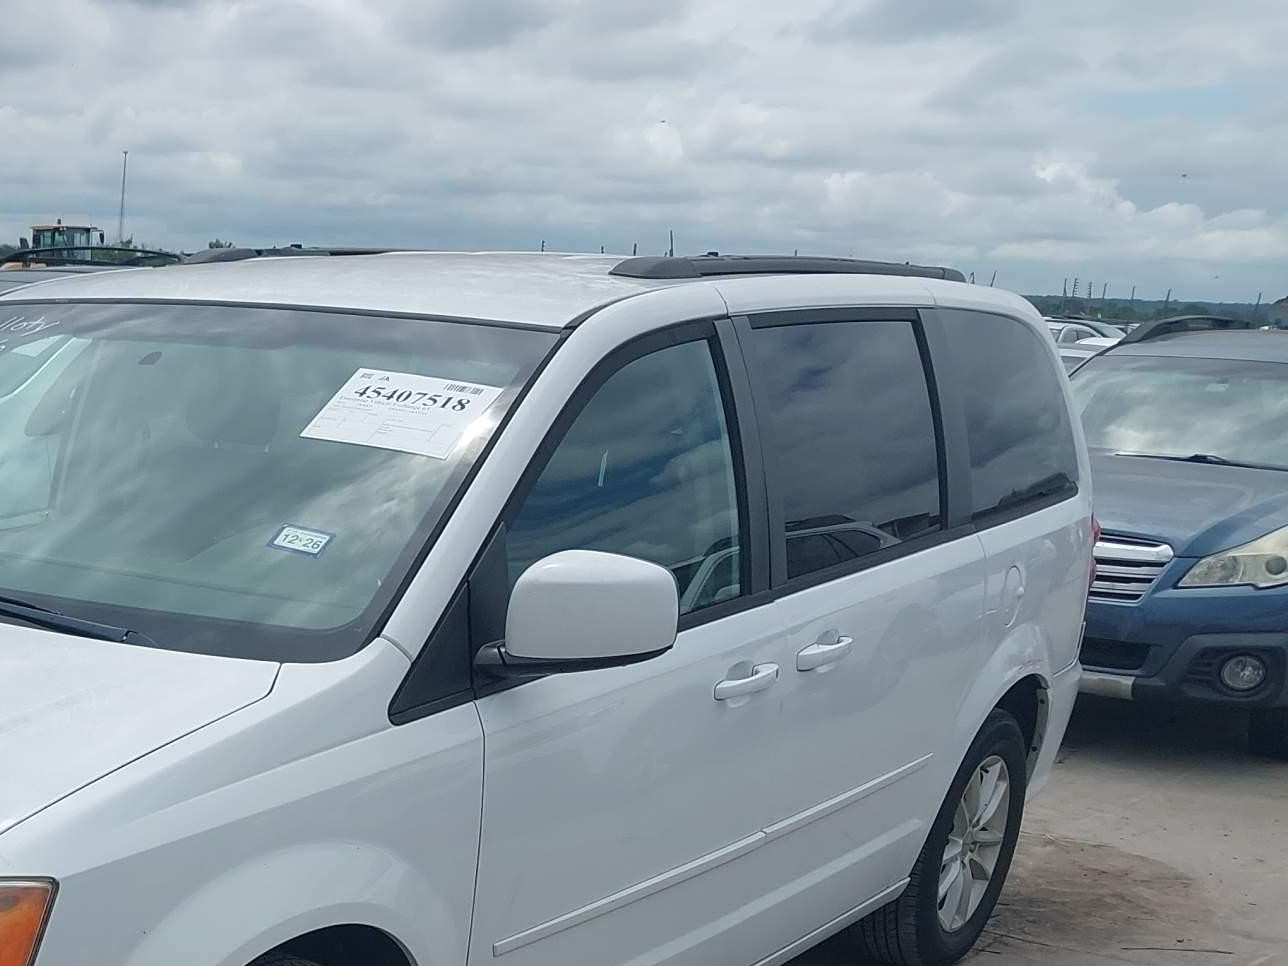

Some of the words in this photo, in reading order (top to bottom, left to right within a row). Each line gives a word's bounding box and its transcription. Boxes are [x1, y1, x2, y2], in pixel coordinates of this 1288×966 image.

[354, 384, 471, 411] 45407518
[282, 533, 299, 544] 12
[302, 538, 322, 549] 26
